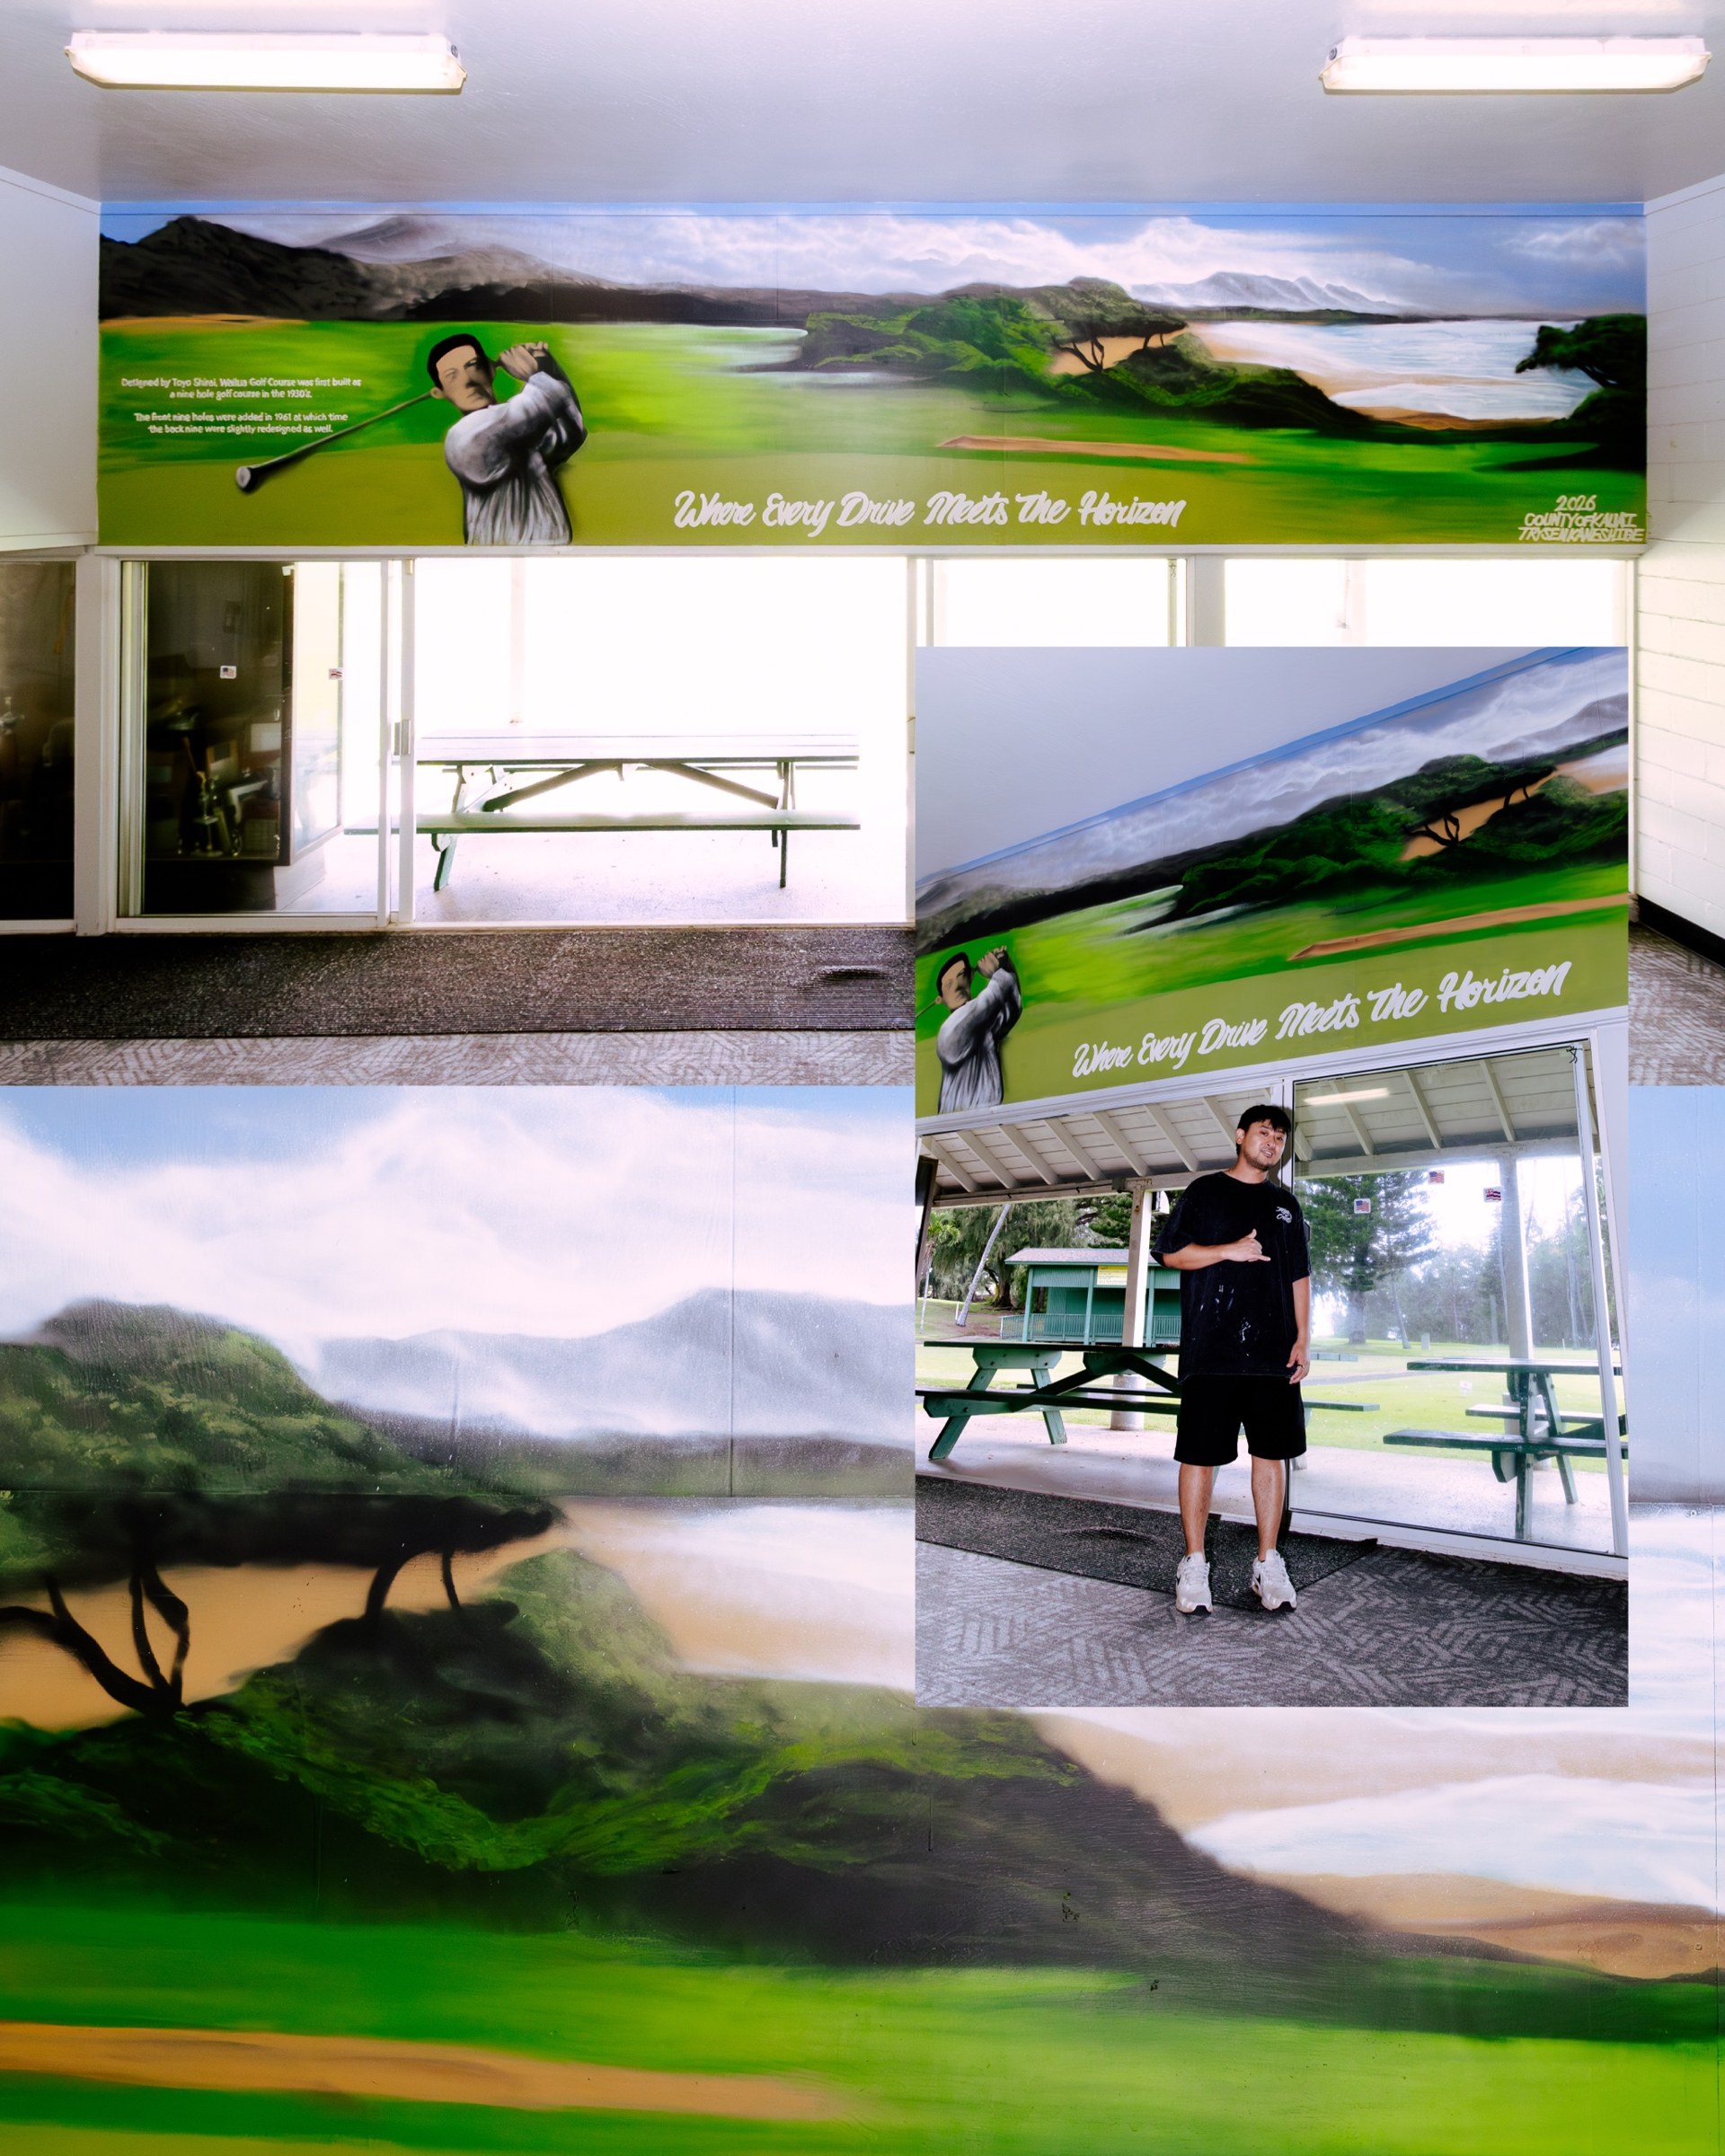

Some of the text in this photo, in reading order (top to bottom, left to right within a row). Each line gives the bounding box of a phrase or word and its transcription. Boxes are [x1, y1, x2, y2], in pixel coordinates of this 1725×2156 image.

[121, 377, 160, 388] Designed
[160, 378, 172, 388] by
[172, 377, 191, 388] Toyo
[219, 378, 248, 387] Wailua
[249, 377, 267, 386] Golf
[267, 377, 296, 387] Course
[296, 379, 314, 387] was
[314, 377, 332, 387] first
[332, 377, 352, 386] built
[351, 379, 362, 387] as
[196, 389, 215, 398] hole
[216, 388, 233, 401] golf
[261, 389, 270, 398] in
[270, 389, 286, 398] the
[134, 412, 151, 421] The
[151, 411, 172, 421] front
[172, 413, 191, 422] nine
[191, 411, 215, 422] holes
[237, 411, 264, 421] added
[264, 412, 273, 421] in
[274, 412, 292, 421] 1961
[293, 413, 302, 421] at
[302, 412, 327, 421] which
[327, 412, 349, 421] time
[147, 425, 164, 434] the
[164, 424, 185, 434] back
[226, 424, 256, 435] slightly
[257, 423, 302, 435] redesigned
[303, 425, 313, 433] as
[314, 424, 332, 433] well.
[1554, 494, 1597, 511] 2026
[674, 490, 1188, 538] Where Every Drive Meets The Horizon
[1072, 961, 1572, 1078] Where Every Drive Meets The Horizon
